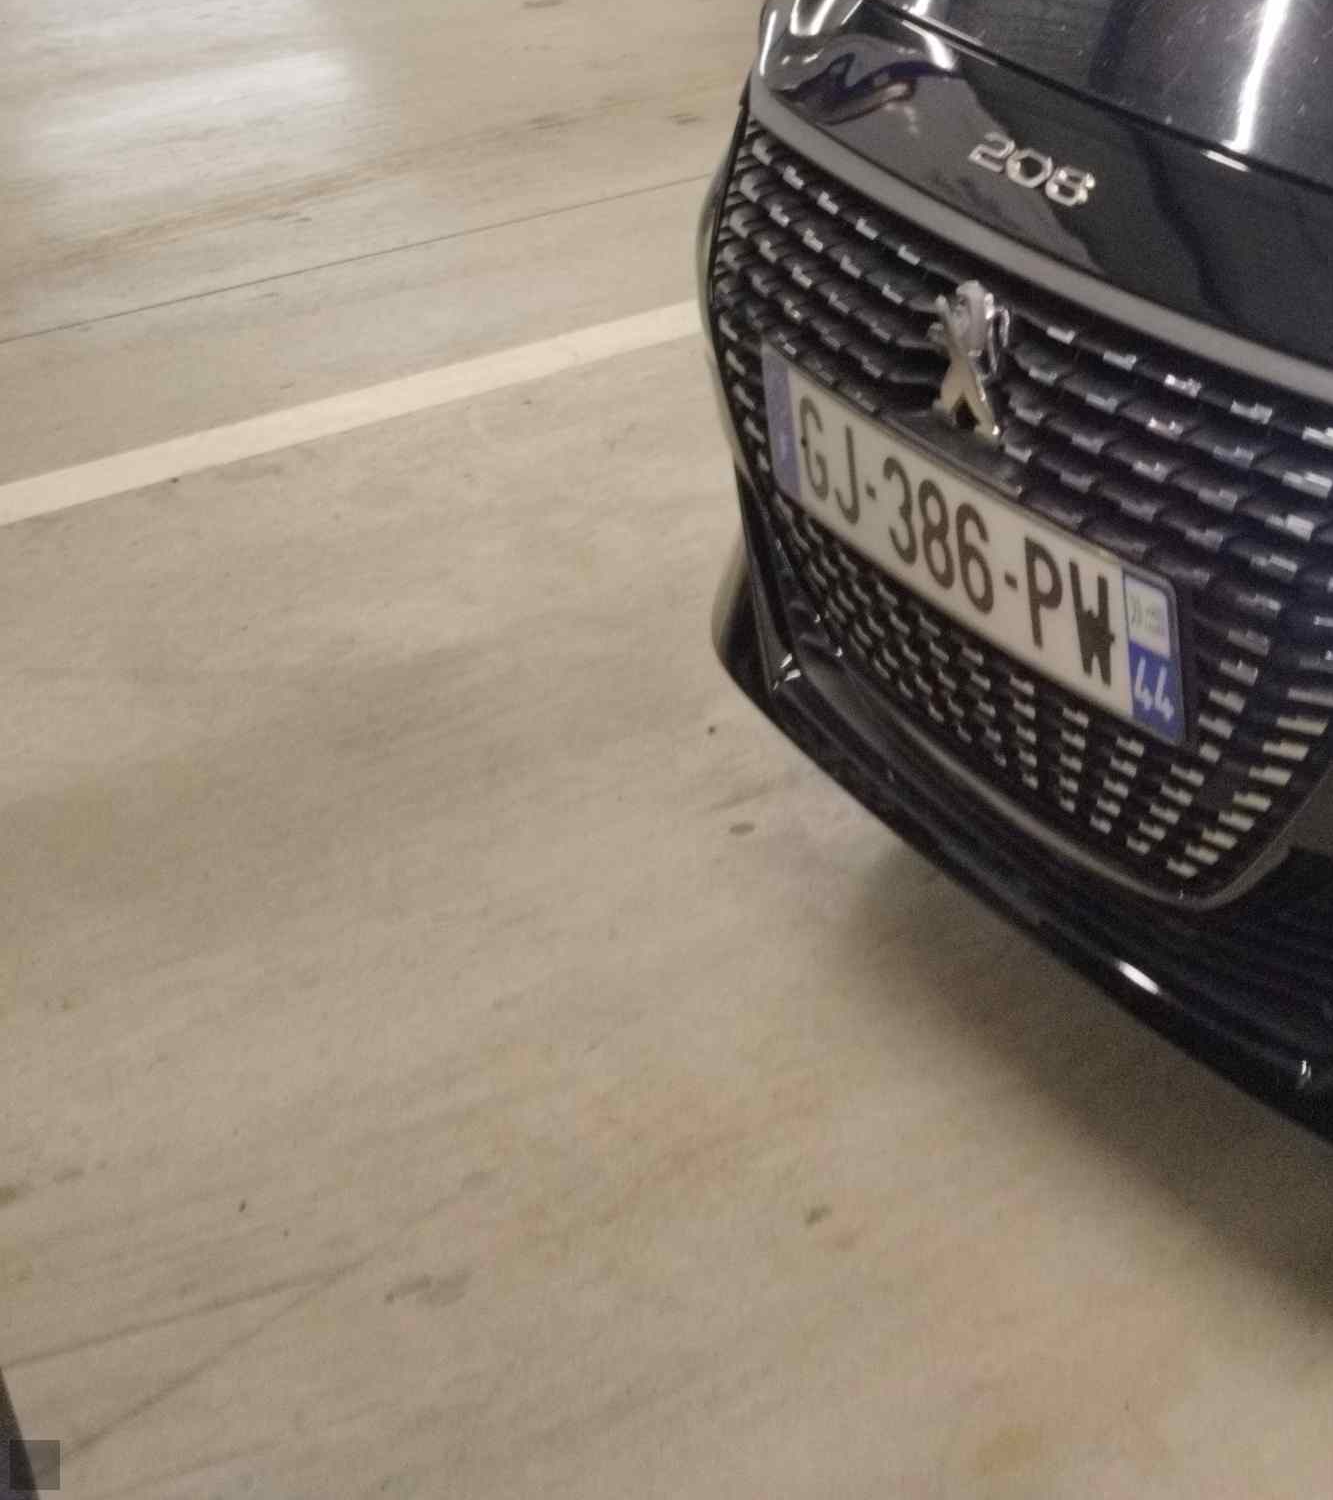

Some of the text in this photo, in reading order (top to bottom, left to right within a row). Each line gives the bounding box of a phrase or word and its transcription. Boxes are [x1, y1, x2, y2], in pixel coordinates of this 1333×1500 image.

[968, 131, 1096, 207] 208
[799, 394, 1115, 686] GJ-386-PW
[1134, 656, 1175, 722] 44
